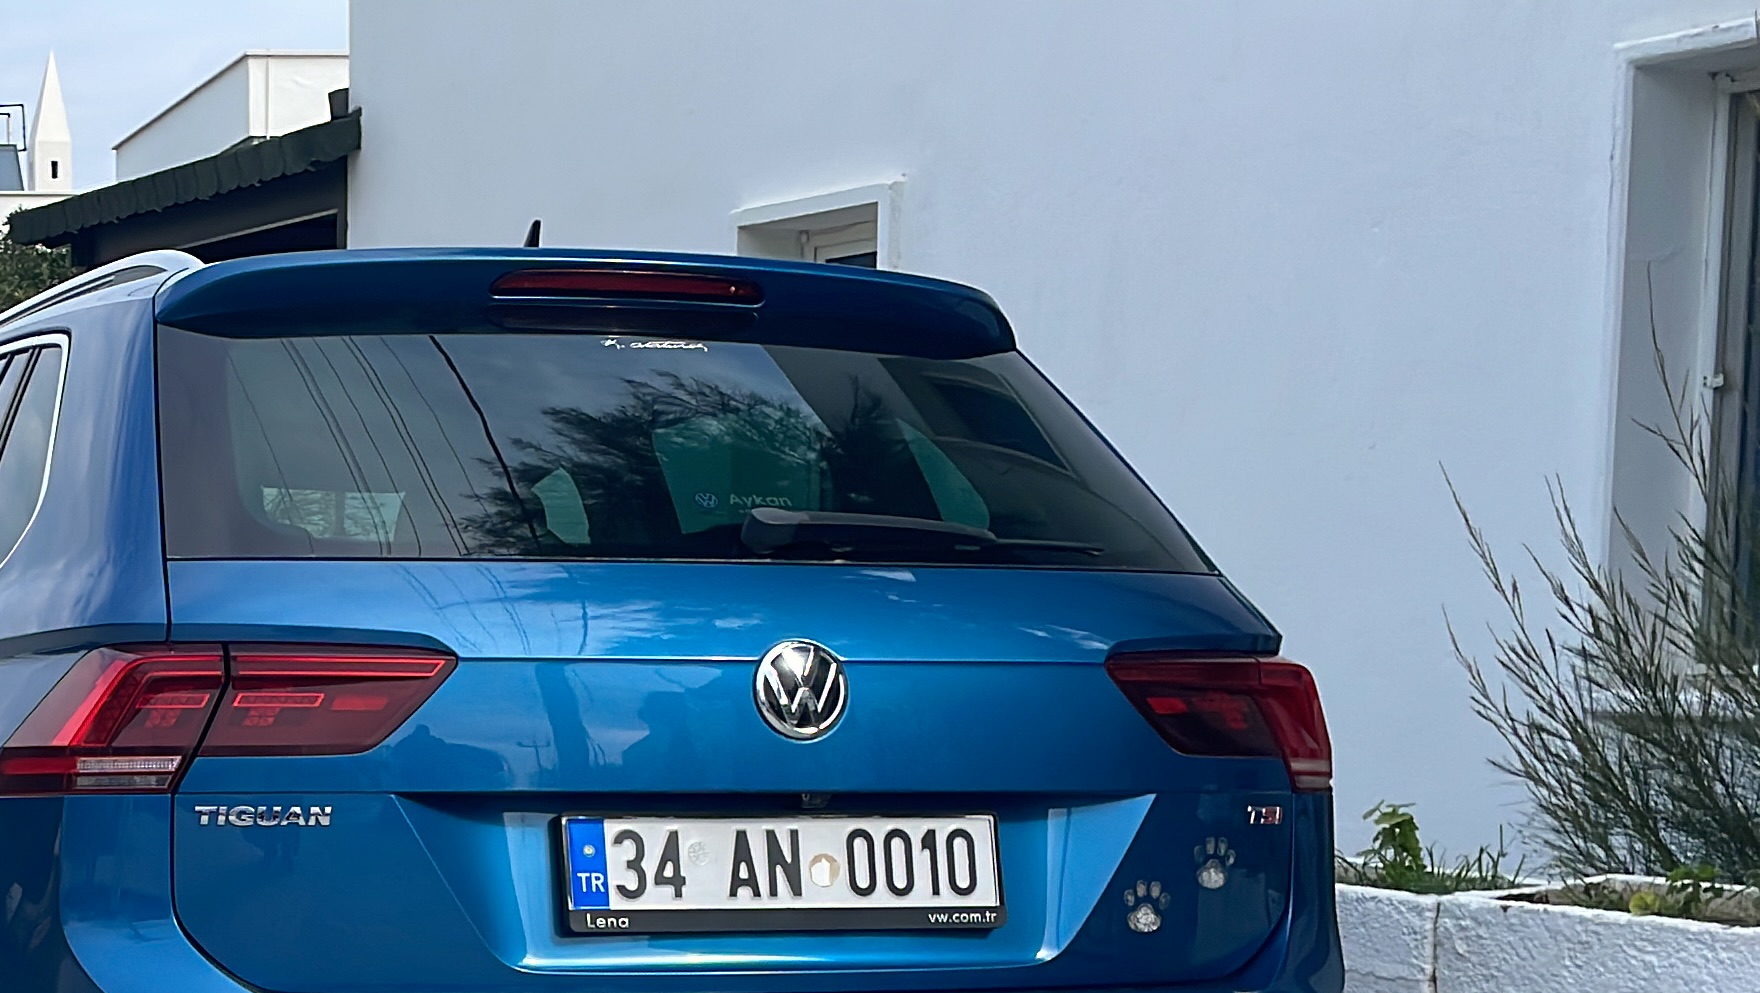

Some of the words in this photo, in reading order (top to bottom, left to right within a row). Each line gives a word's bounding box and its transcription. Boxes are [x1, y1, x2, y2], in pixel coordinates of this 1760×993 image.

[729, 493, 792, 507] Aykan
[194, 805, 332, 827] TIGUAN
[612, 829, 687, 899] 34
[728, 828, 803, 898] AN
[845, 828, 978, 897] 0010
[577, 872, 606, 893] TR
[586, 913, 630, 929] Lena
[927, 910, 998, 923] vw.com.tr
